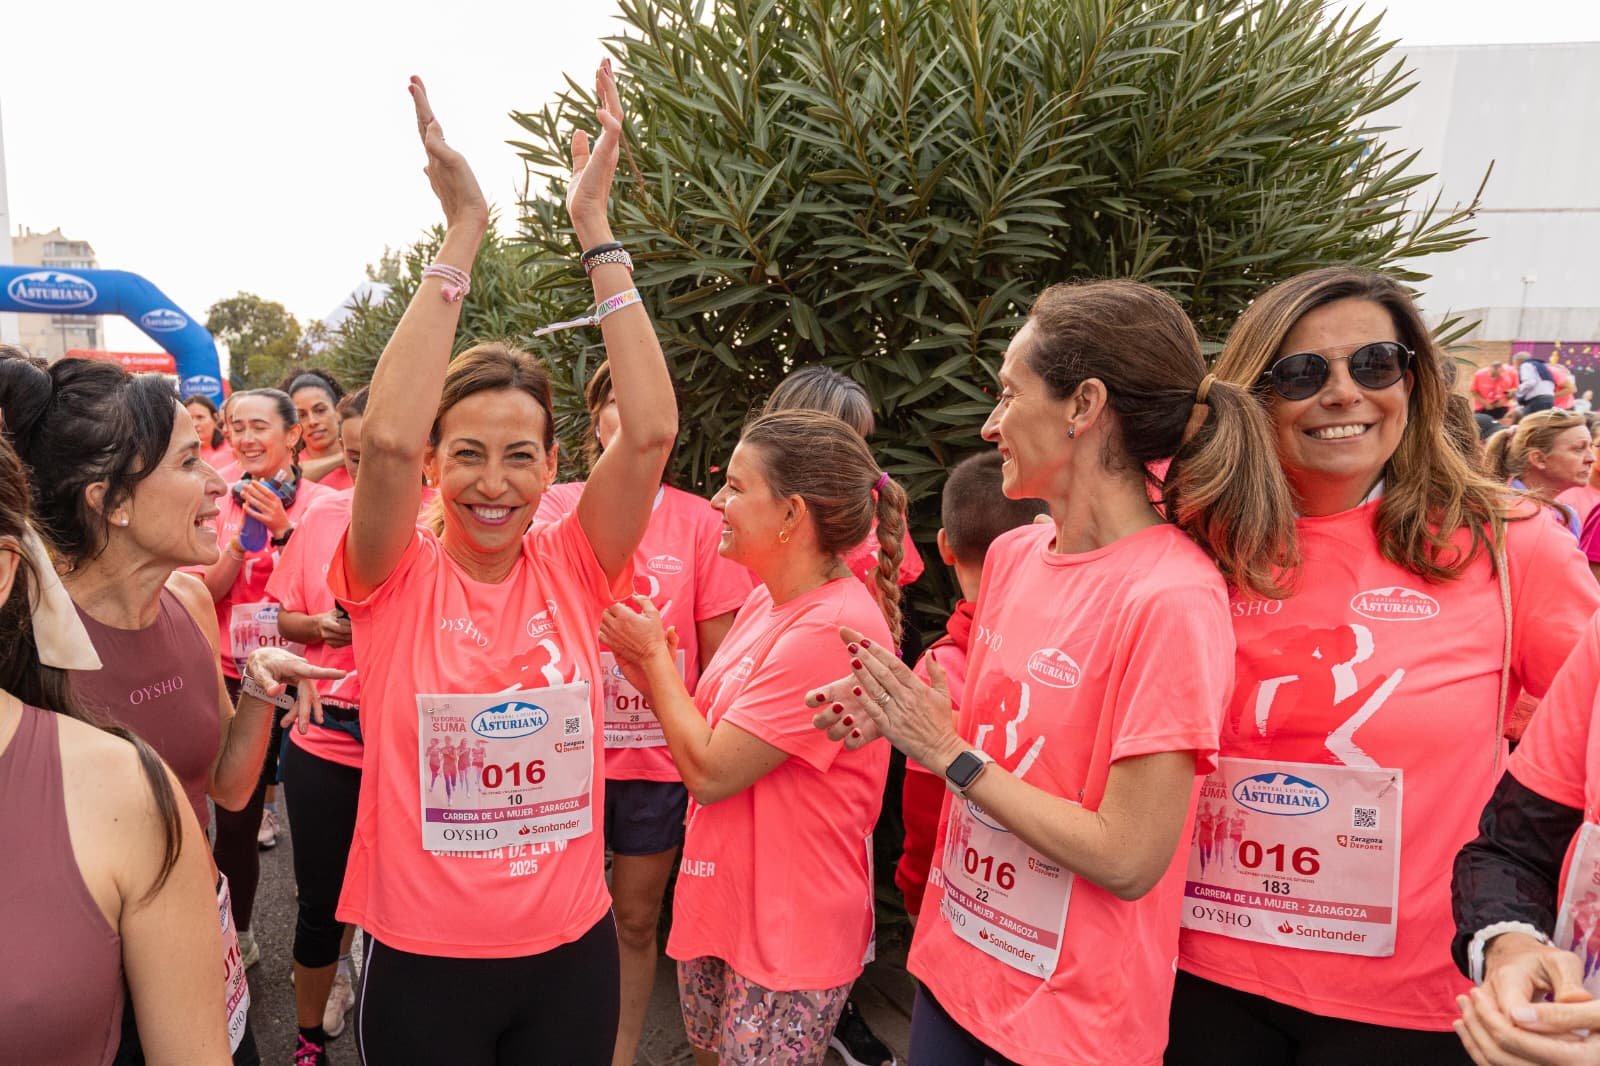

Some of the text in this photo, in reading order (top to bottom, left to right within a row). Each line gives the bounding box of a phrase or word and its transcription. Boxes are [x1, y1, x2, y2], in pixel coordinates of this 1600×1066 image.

[17, 281, 90, 301] ASTURIANA
[1230, 599, 1283, 617] SHO
[1357, 596, 1433, 615] ASTURIANA
[1029, 655, 1075, 685] ASTURIANA
[129, 675, 184, 705] OYSHO
[432, 722, 466, 733] SUMA
[478, 716, 543, 732] ASTURIANA
[603, 734, 624, 742] SHO
[482, 759, 546, 789] 016
[507, 794, 523, 806] 10
[1239, 785, 1321, 808] ASTURIANA
[443, 811, 480, 821] CARRERA
[481, 810, 493, 820] DE
[494, 809, 505, 819] LA
[507, 808, 533, 819] MUJER
[540, 800, 580, 814] ZARAGOZA
[443, 829, 498, 841] OYSHO
[532, 819, 580, 834] Santander
[508, 843, 527, 858] DE
[531, 841, 550, 856] LA
[1349, 835, 1383, 845] Zaragoza
[1238, 840, 1321, 876] 016
[509, 859, 538, 877] 2025
[964, 847, 1016, 891] 016
[975, 887, 989, 903] 22
[1261, 879, 1291, 896] 183
[1194, 886, 1232, 902] CARRERA
[1233, 892, 1246, 904] DE
[1248, 894, 1262, 906] LA
[1264, 896, 1299, 911] MUJER
[1307, 903, 1368, 919] ZARAGOZA
[947, 900, 966, 928] SHO
[959, 894, 966, 905] DE
[966, 899, 973, 909] LA
[973, 903, 995, 921] MUJER
[999, 916, 1039, 941] ZARAGOZA
[1192, 905, 1252, 928] OYSHO
[1296, 925, 1367, 943] Santander
[989, 933, 1037, 962] Santander
[228, 1009, 245, 1040] YSHO
